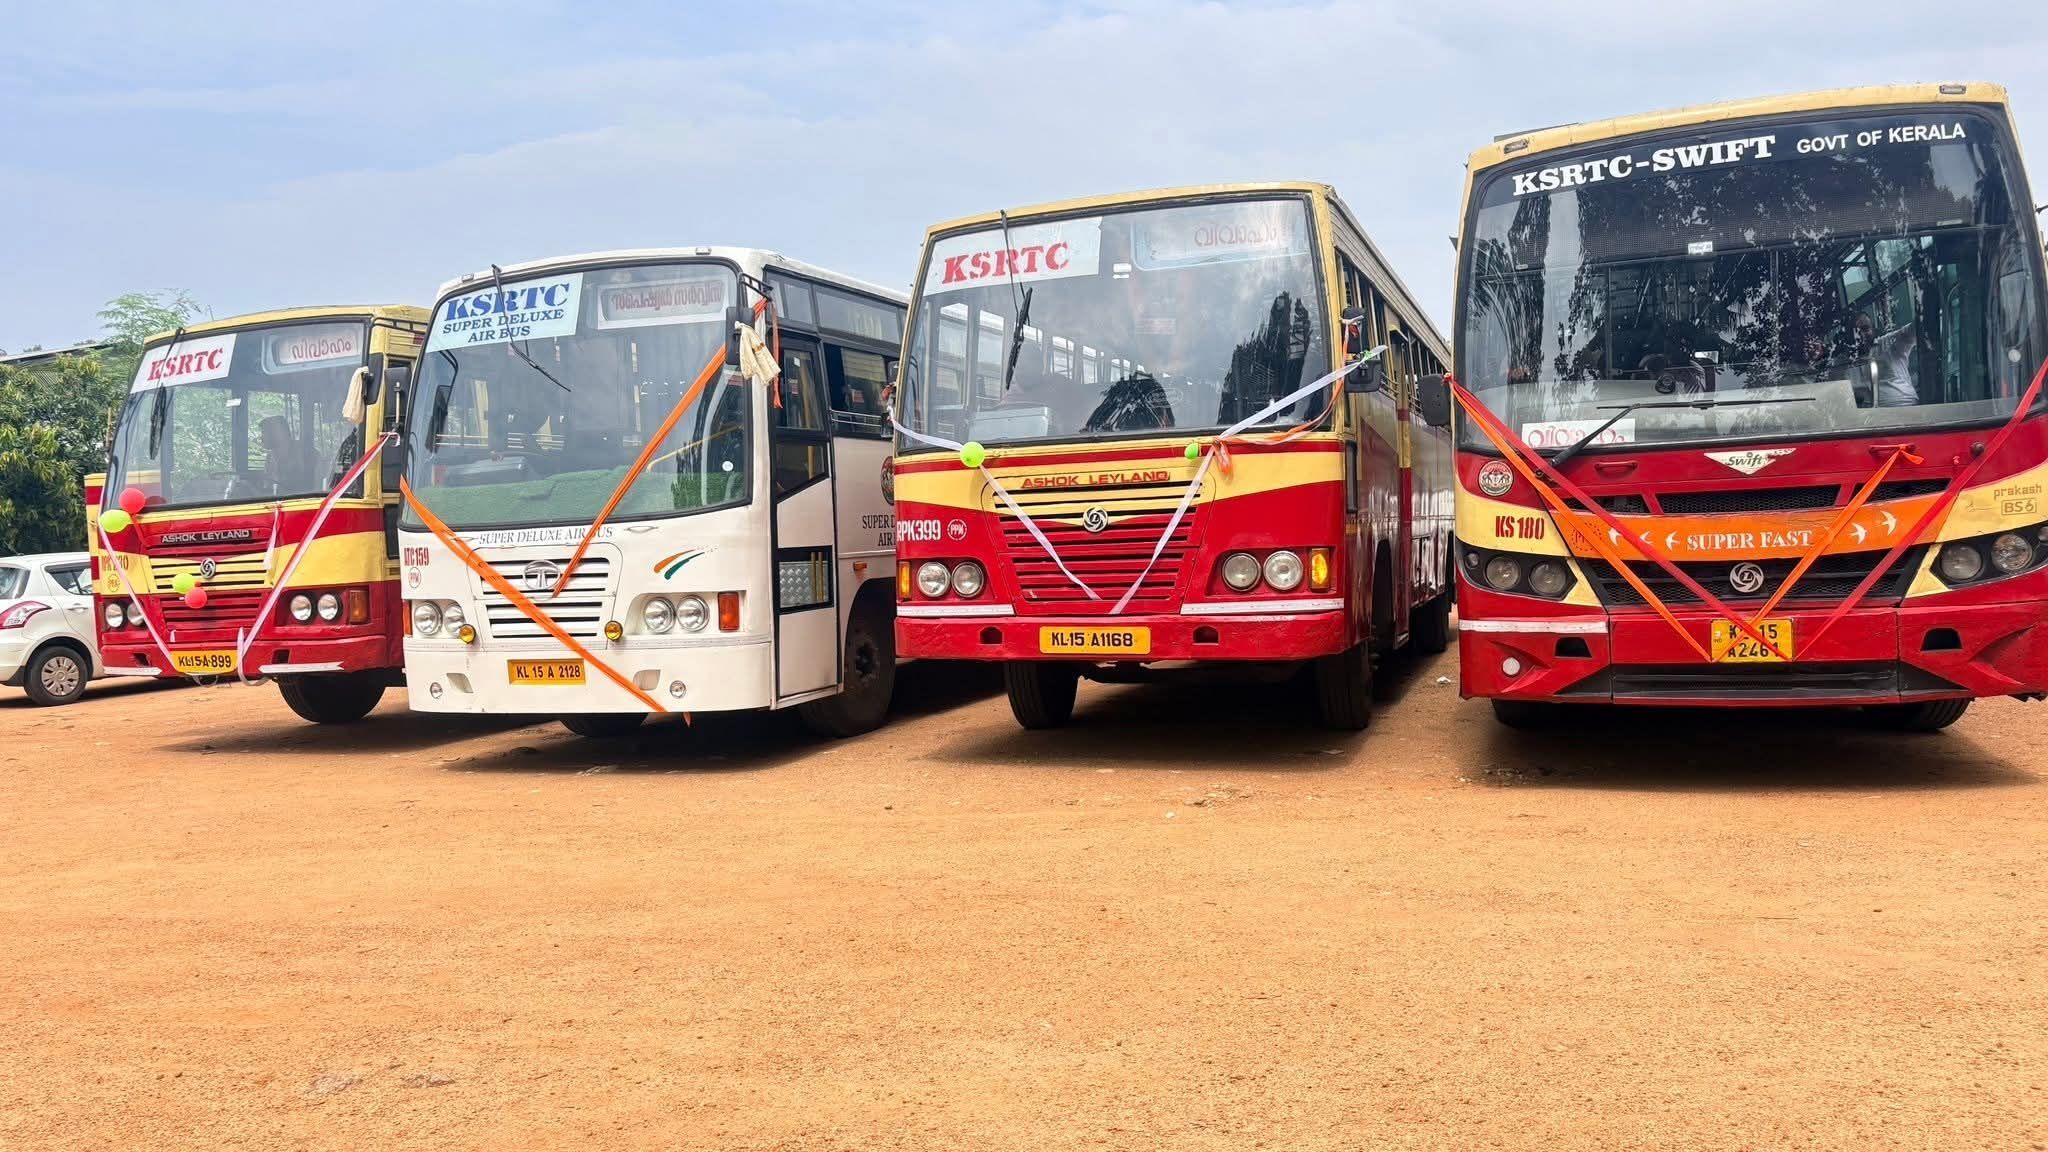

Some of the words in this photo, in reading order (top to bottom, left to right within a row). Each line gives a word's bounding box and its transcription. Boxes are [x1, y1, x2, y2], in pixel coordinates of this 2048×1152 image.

[1797, 134, 1849, 154] GOVT
[1857, 130, 1882, 147] OF
[1888, 123, 1966, 143] KERALA
[1512, 135, 1776, 196] KSRTC-SWIFT
[942, 242, 1069, 284] KSRTC
[444, 283, 570, 321] KSRTC
[443, 317, 491, 334] SUPER
[497, 308, 564, 327] DELUXE
[468, 330, 495, 343] AIR
[500, 326, 531, 339] BUS
[147, 348, 223, 381] KSRTC
[1728, 452, 1762, 467] Swift
[1022, 476, 1079, 489] ASHOK
[1089, 471, 1170, 485] LEYLAND
[1993, 483, 2042, 500] prakash
[2004, 500, 2034, 514] BS6
[862, 515, 890, 529] SUPER
[896, 519, 941, 541] RPK399
[162, 534, 196, 543] ASHOK
[201, 530, 249, 541] LEYLAND
[479, 531, 515, 545] SUPER
[518, 528, 562, 543] DELUXE
[565, 527, 586, 541] AIR
[1687, 533, 1754, 551] SUPER
[1760, 530, 1813, 549] FAST
[1091, 632, 1133, 647] A1168
[1759, 624, 1778, 639] 15
[517, 665, 529, 678] KL
[533, 665, 544, 678] 15
[548, 665, 555, 678] A
[559, 664, 581, 678] 2128
